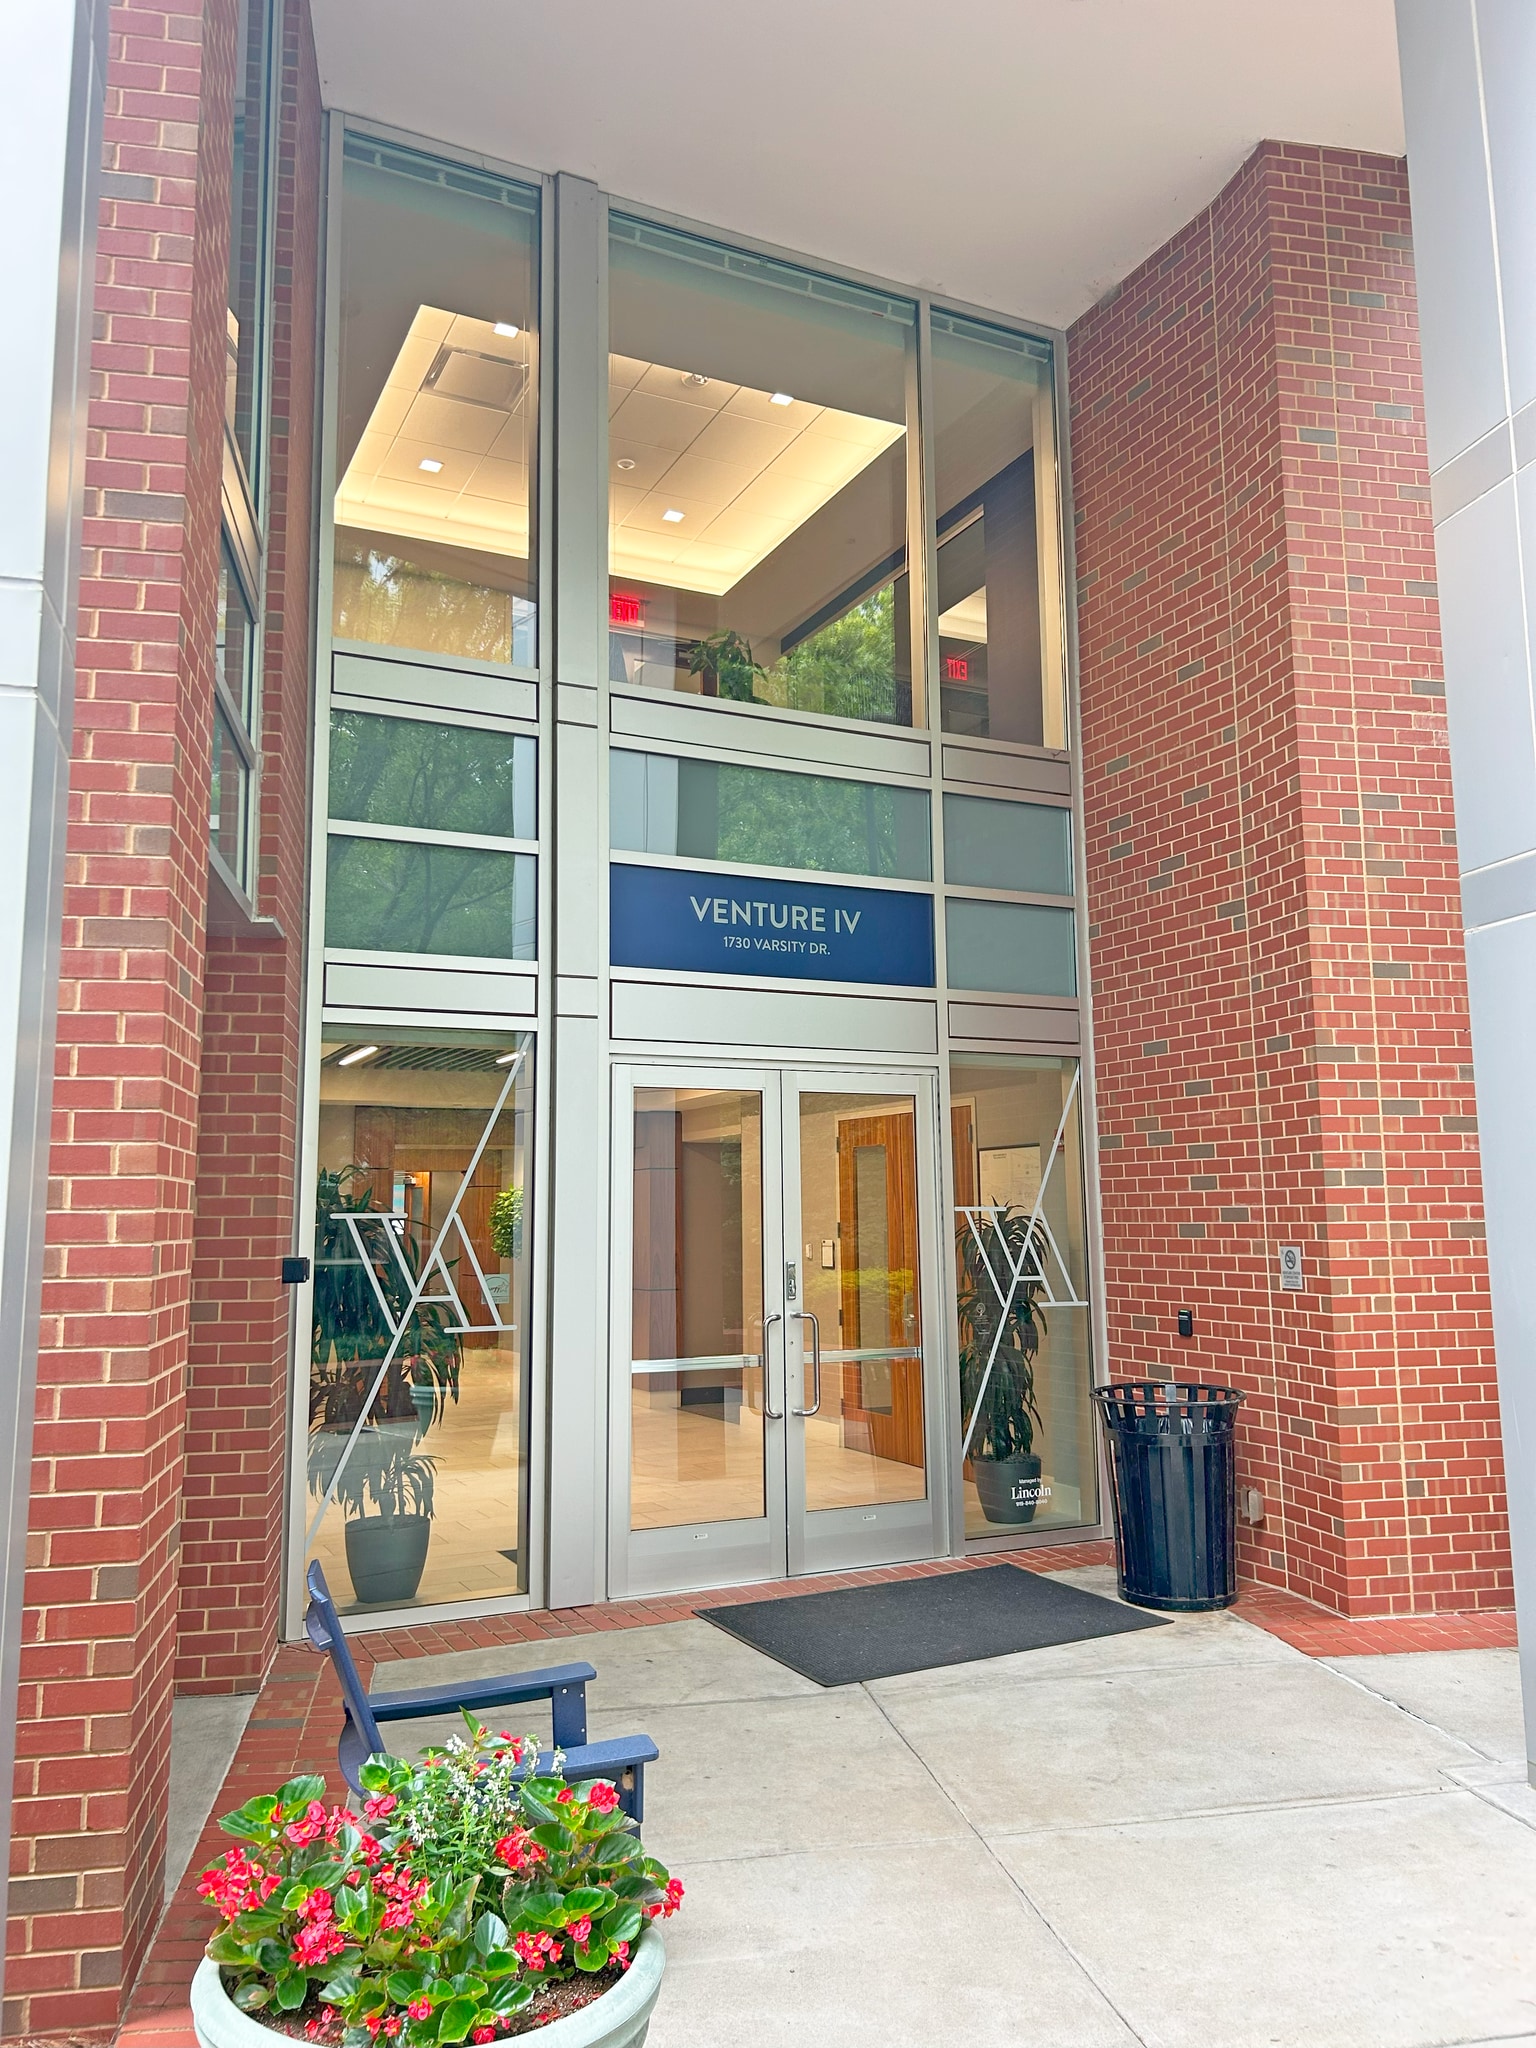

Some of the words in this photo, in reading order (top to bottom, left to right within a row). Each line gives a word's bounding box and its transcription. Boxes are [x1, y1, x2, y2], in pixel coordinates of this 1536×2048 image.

[611, 597, 639, 624] EXIT
[689, 895, 827, 932] VENTURE
[834, 909, 862, 935] IV
[723, 935, 751, 950] 1730
[753, 937, 807, 954] VARSITY
[809, 942, 831, 956] DR.
[1011, 1484, 1051, 1500] Lincoln
